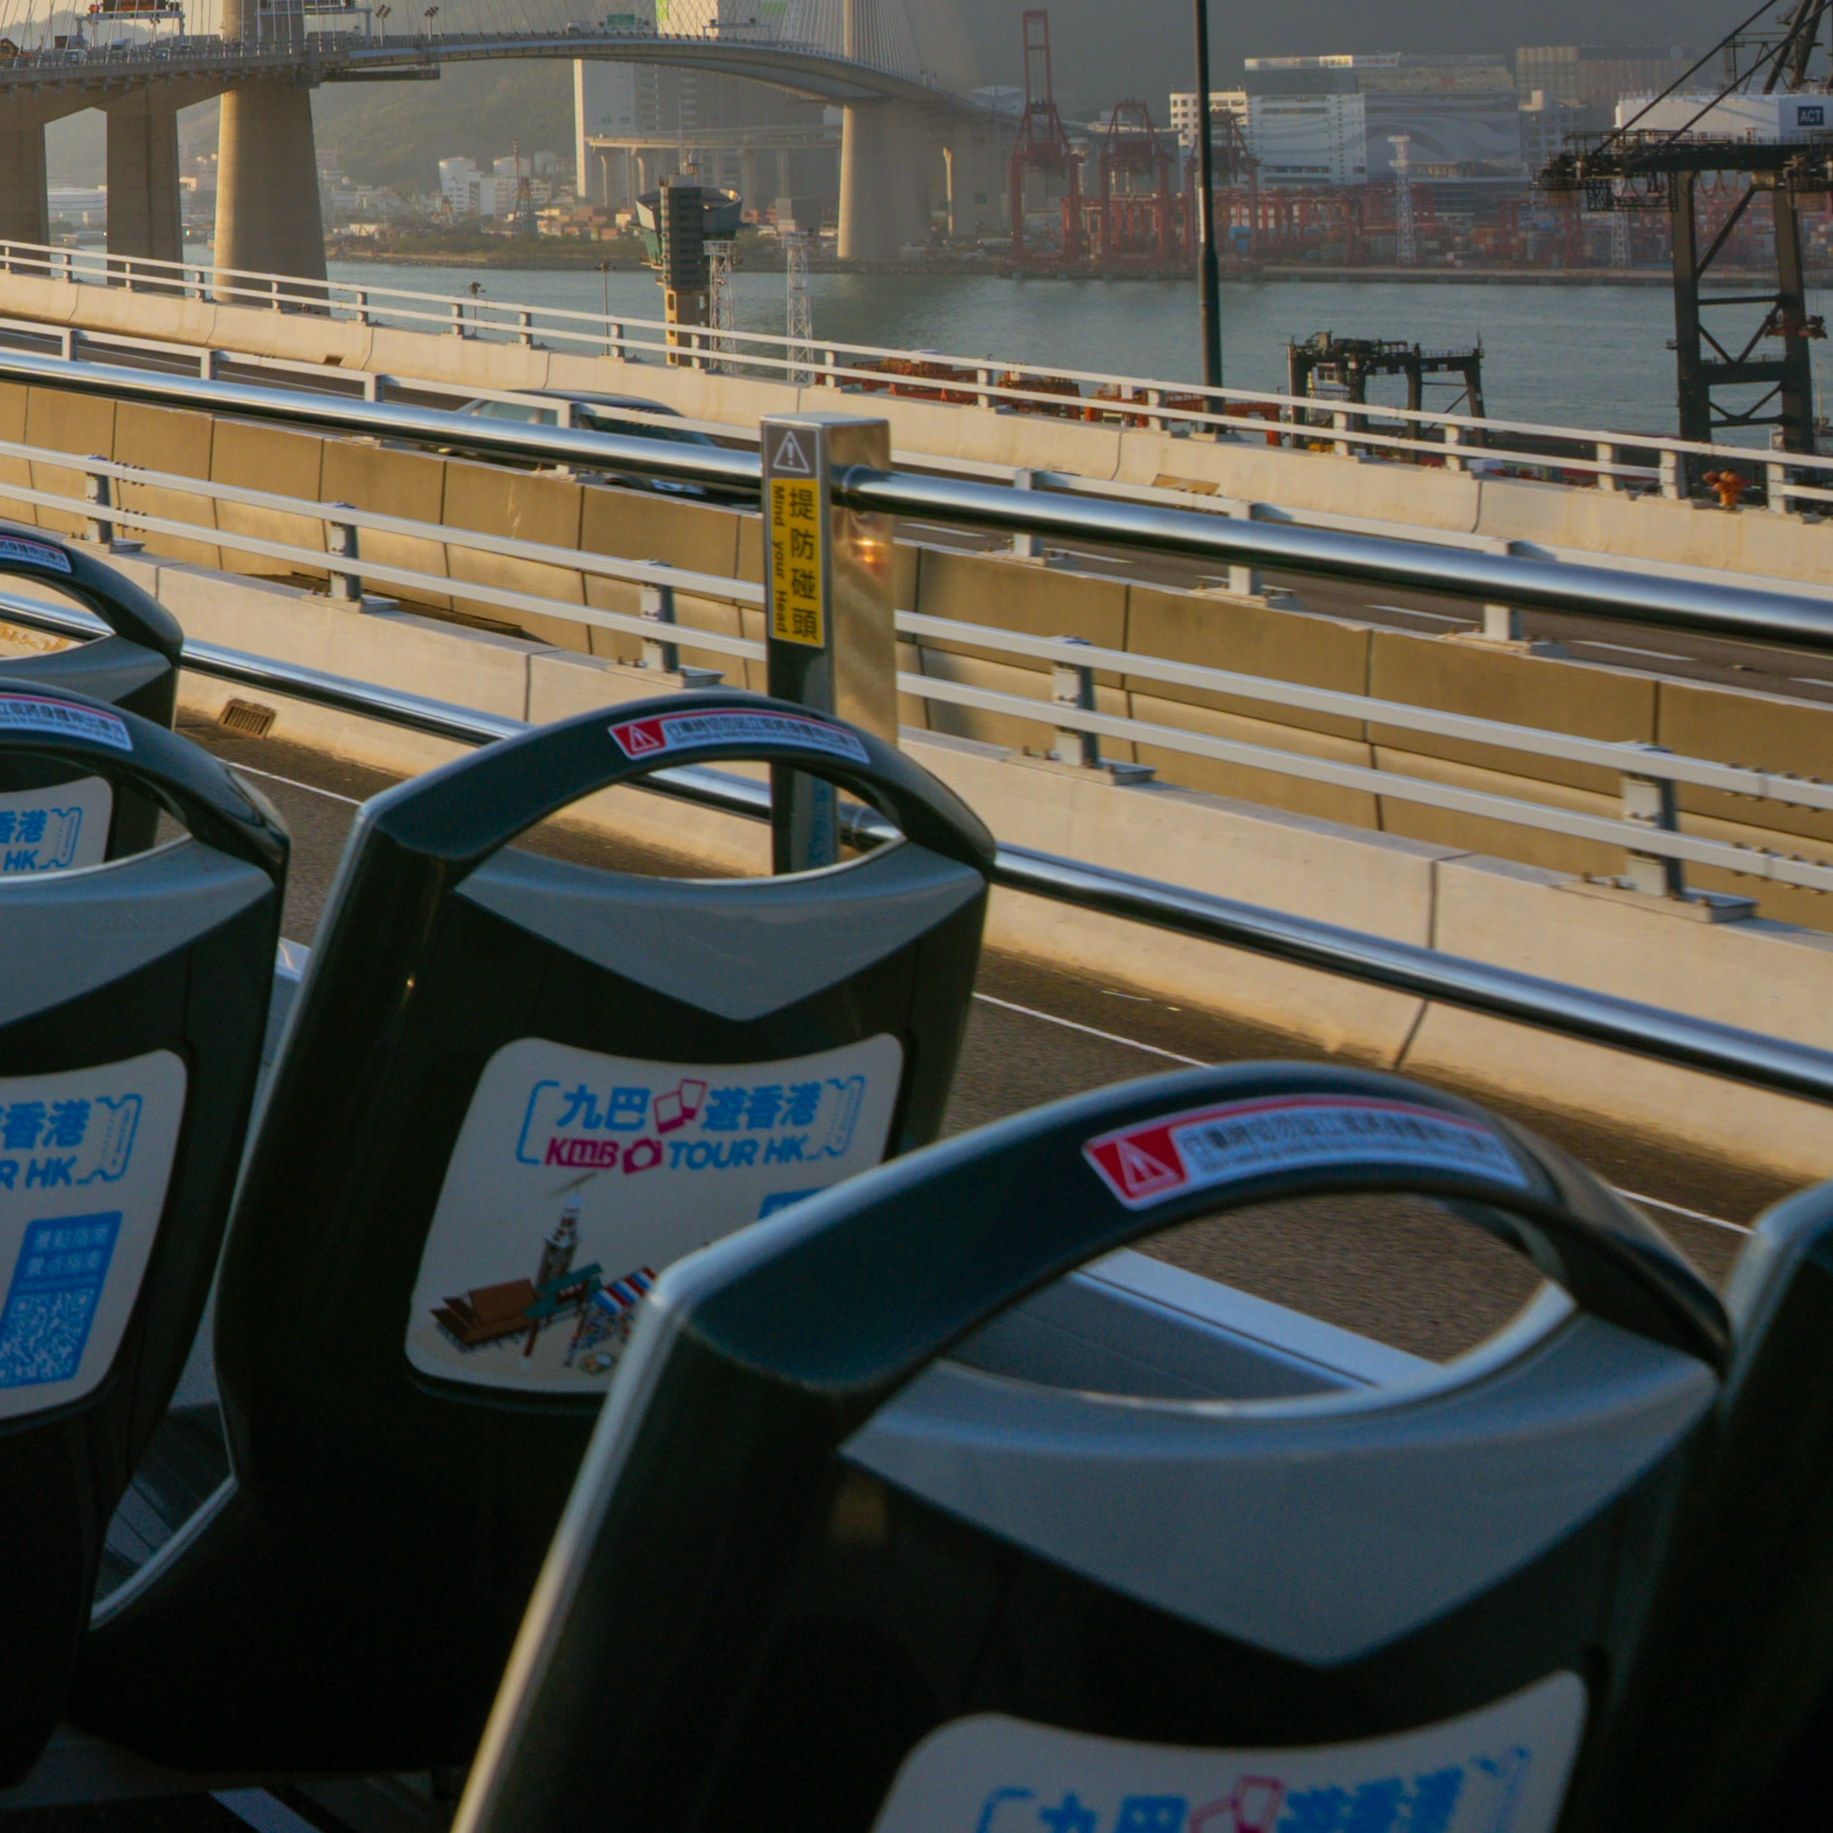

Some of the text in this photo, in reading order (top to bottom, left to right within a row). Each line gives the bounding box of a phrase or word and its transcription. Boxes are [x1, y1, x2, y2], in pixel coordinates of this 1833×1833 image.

[1800, 110, 1821, 122] ACT
[771, 486, 788, 633] Mind your Head
[789, 487, 818, 641] 提防碰頭
[4, 848, 39, 872] HK
[556, 1082, 822, 1131] 九巴 遊香港
[544, 1134, 808, 1169] KMB TOUR HK
[25, 1156, 77, 1189] HK
